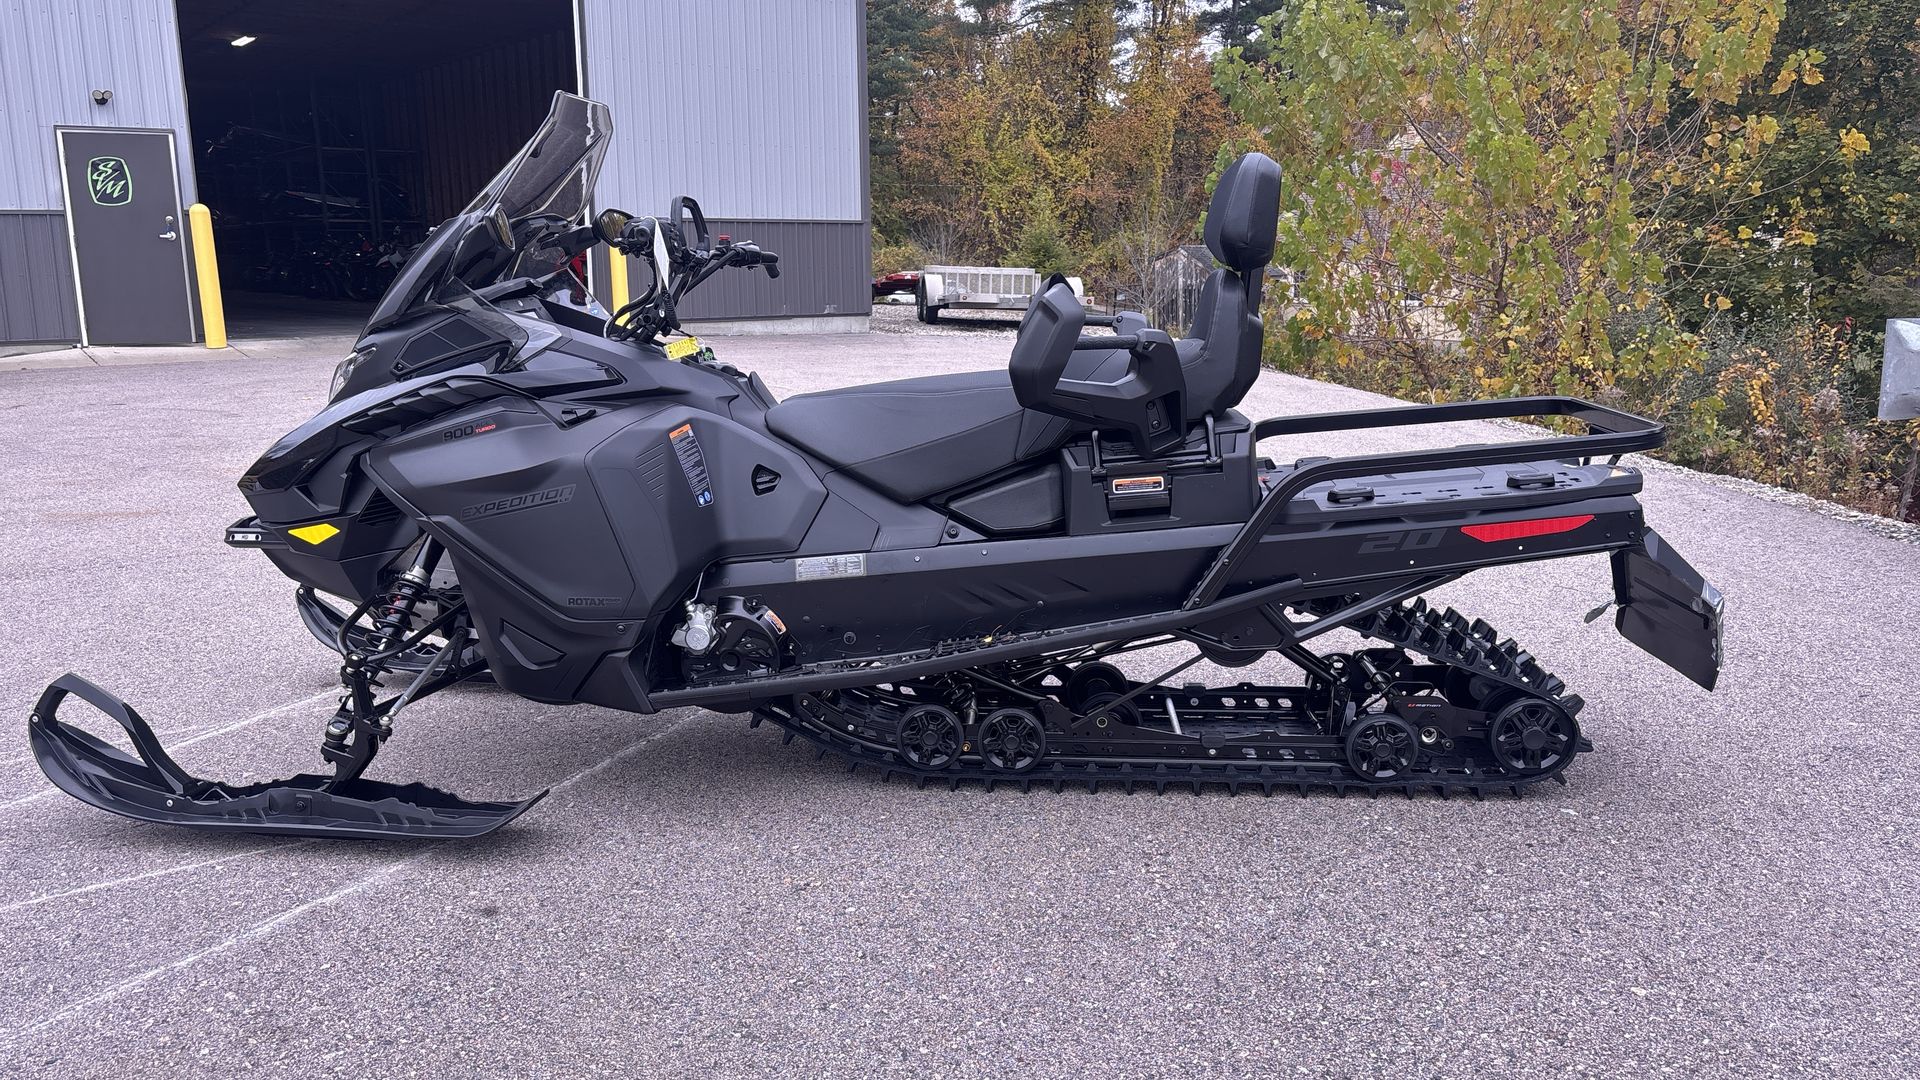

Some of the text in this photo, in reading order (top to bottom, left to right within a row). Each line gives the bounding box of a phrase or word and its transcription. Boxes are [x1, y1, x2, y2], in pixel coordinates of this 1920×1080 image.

[443, 424, 474, 442] 900
[461, 485, 574, 519] EXPEDITION
[1357, 527, 1449, 554] 20
[567, 597, 606, 607] ROTAX
